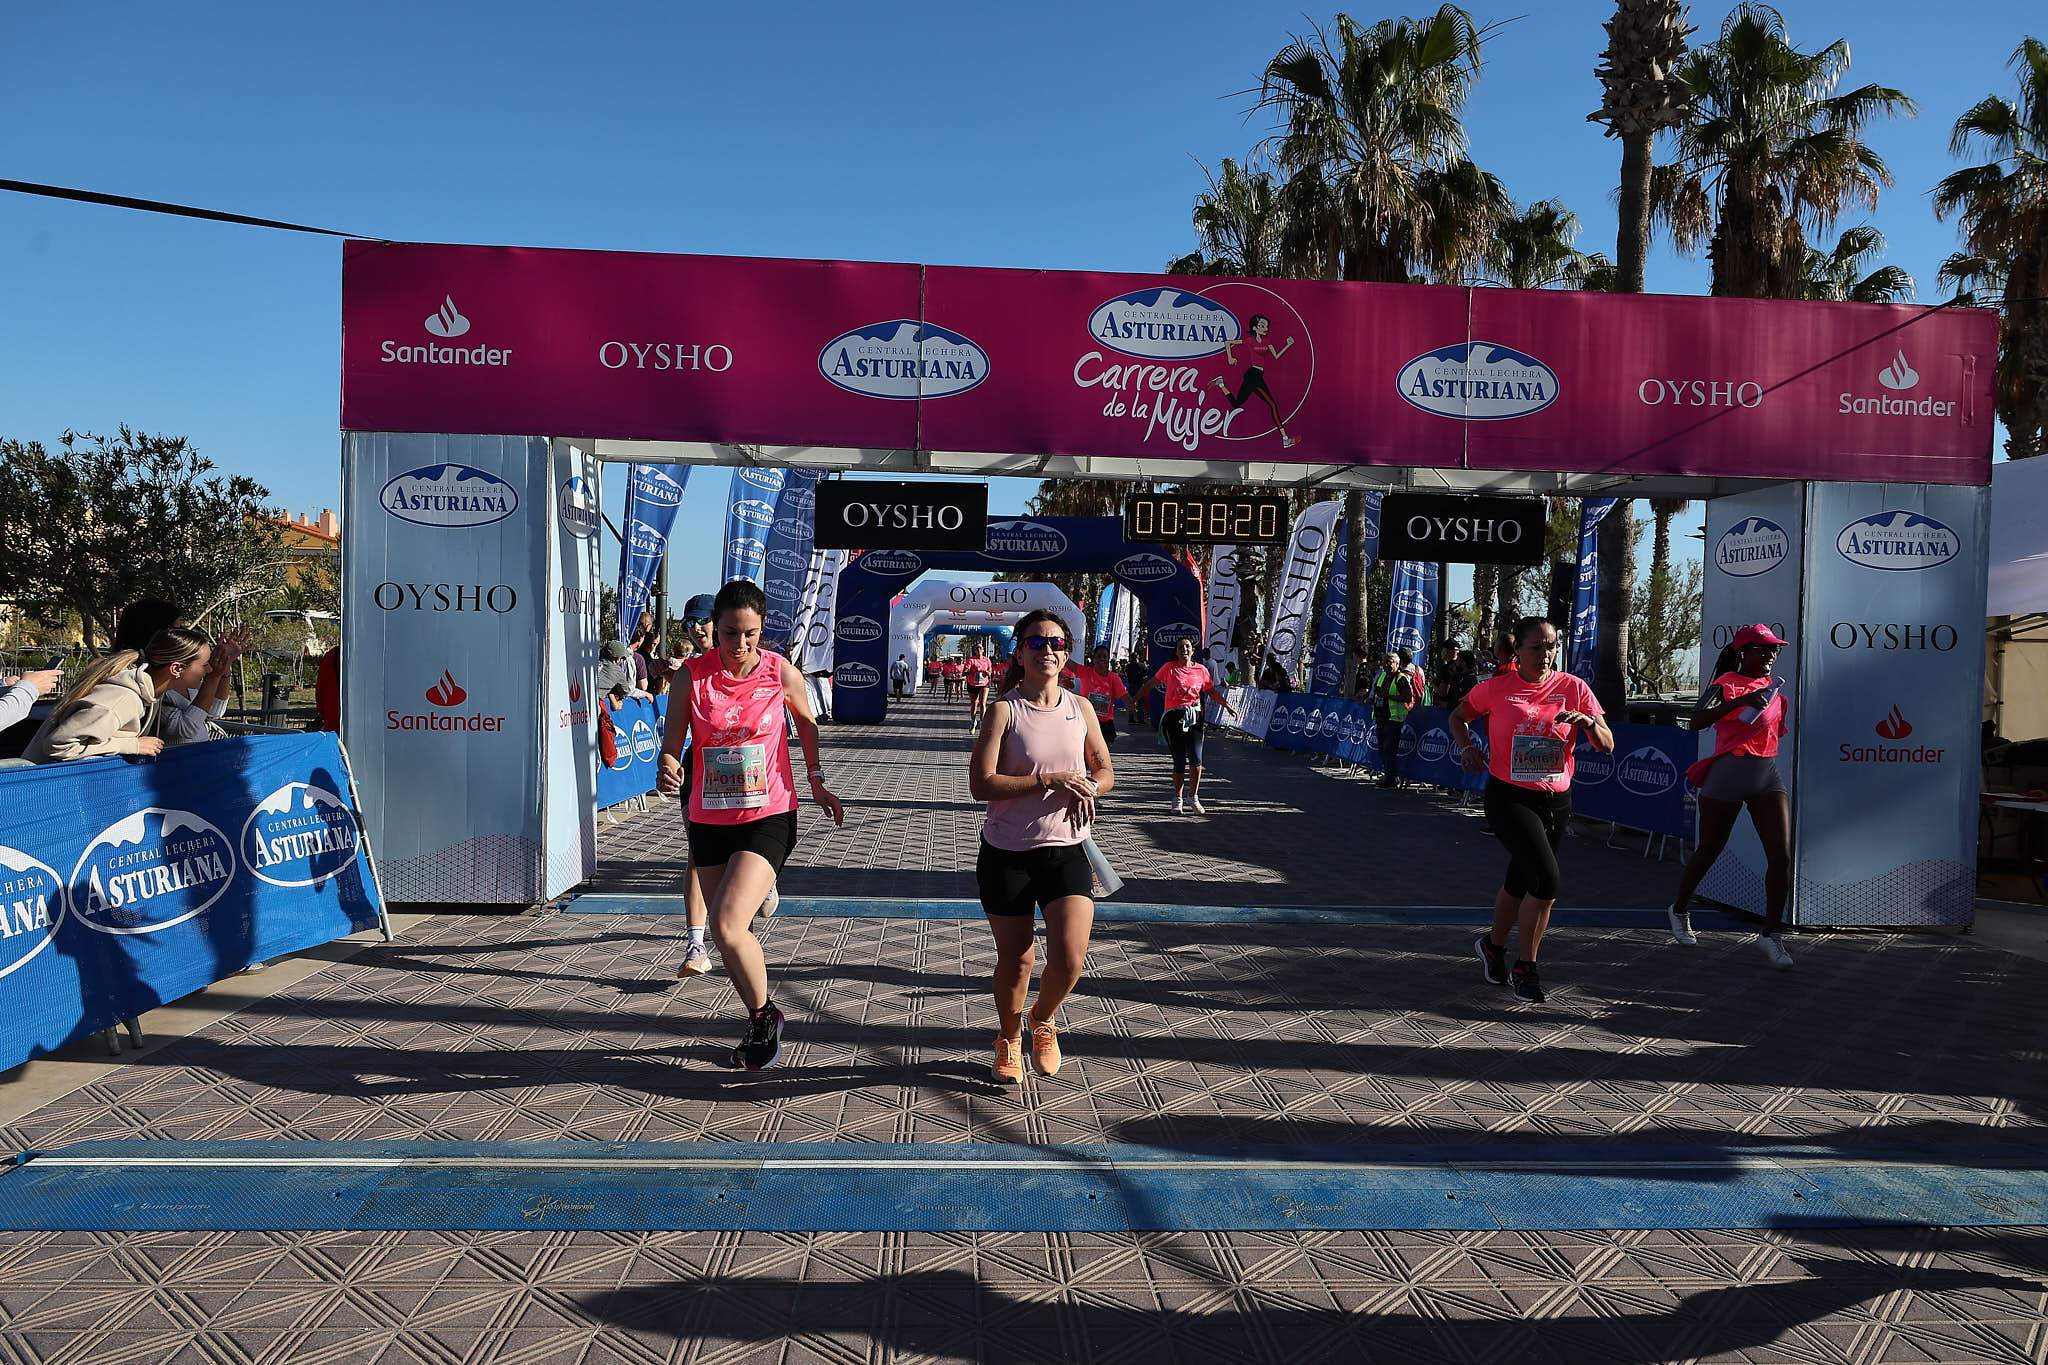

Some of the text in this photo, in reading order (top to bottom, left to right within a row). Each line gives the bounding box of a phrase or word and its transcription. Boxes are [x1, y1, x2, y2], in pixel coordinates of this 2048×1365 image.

[1100, 311, 1228, 343] ASTURIANA
[1123, 310, 1226, 322] CENTRAL LECHERA
[380, 340, 512, 367] Santander
[599, 341, 734, 372] OYSHO
[832, 347, 976, 380] ASTURIANA
[858, 346, 912, 355] CENTRAL
[1073, 351, 1199, 393] Carrera
[1409, 368, 1547, 401] ASTURIANA
[1434, 367, 1542, 379] CENTRAL LECHERA
[1638, 378, 1763, 409] OYSHO
[1838, 392, 1955, 418] Santander
[1103, 390, 1244, 451] de la Mujer
[390, 486, 508, 512] ASTURIANA
[411, 485, 504, 494] CENTRAL LECHERA
[634, 480, 679, 503] TURIANA
[843, 502, 963, 530] OYSHO
[1137, 501, 1276, 537] 00:38:20
[1406, 515, 1522, 544] OYSHO
[989, 538, 1060, 552] STURIANA
[1719, 542, 1782, 565] ASTURIANA
[1845, 531, 1950, 557] ASTURIANA
[864, 556, 917, 569] ASTURIANA
[1118, 564, 1173, 576] ASTURIANA
[373, 581, 517, 614] OYSHO
[558, 585, 595, 616] OYSHO
[950, 587, 1028, 604] OYSHO
[1271, 525, 1325, 655] OYSHO
[837, 624, 879, 636] ASTURIANA
[1712, 622, 1785, 650] OYO
[1830, 622, 1958, 651] OYSHO
[835, 670, 877, 682] ASTURIANA
[386, 710, 505, 732] Santander
[1839, 743, 1945, 764] Santander
[1574, 760, 1610, 776] STURIANA
[1620, 761, 1669, 786] ASTURIANA
[268, 817, 308, 833] CENTRAL
[109, 836, 216, 869] CENTRAL LECHERA
[255, 825, 355, 869] ASTURIANA
[0, 875, 43, 897] HERA
[85, 851, 228, 915] ASTURIANA
[0, 894, 53, 939] ANA
